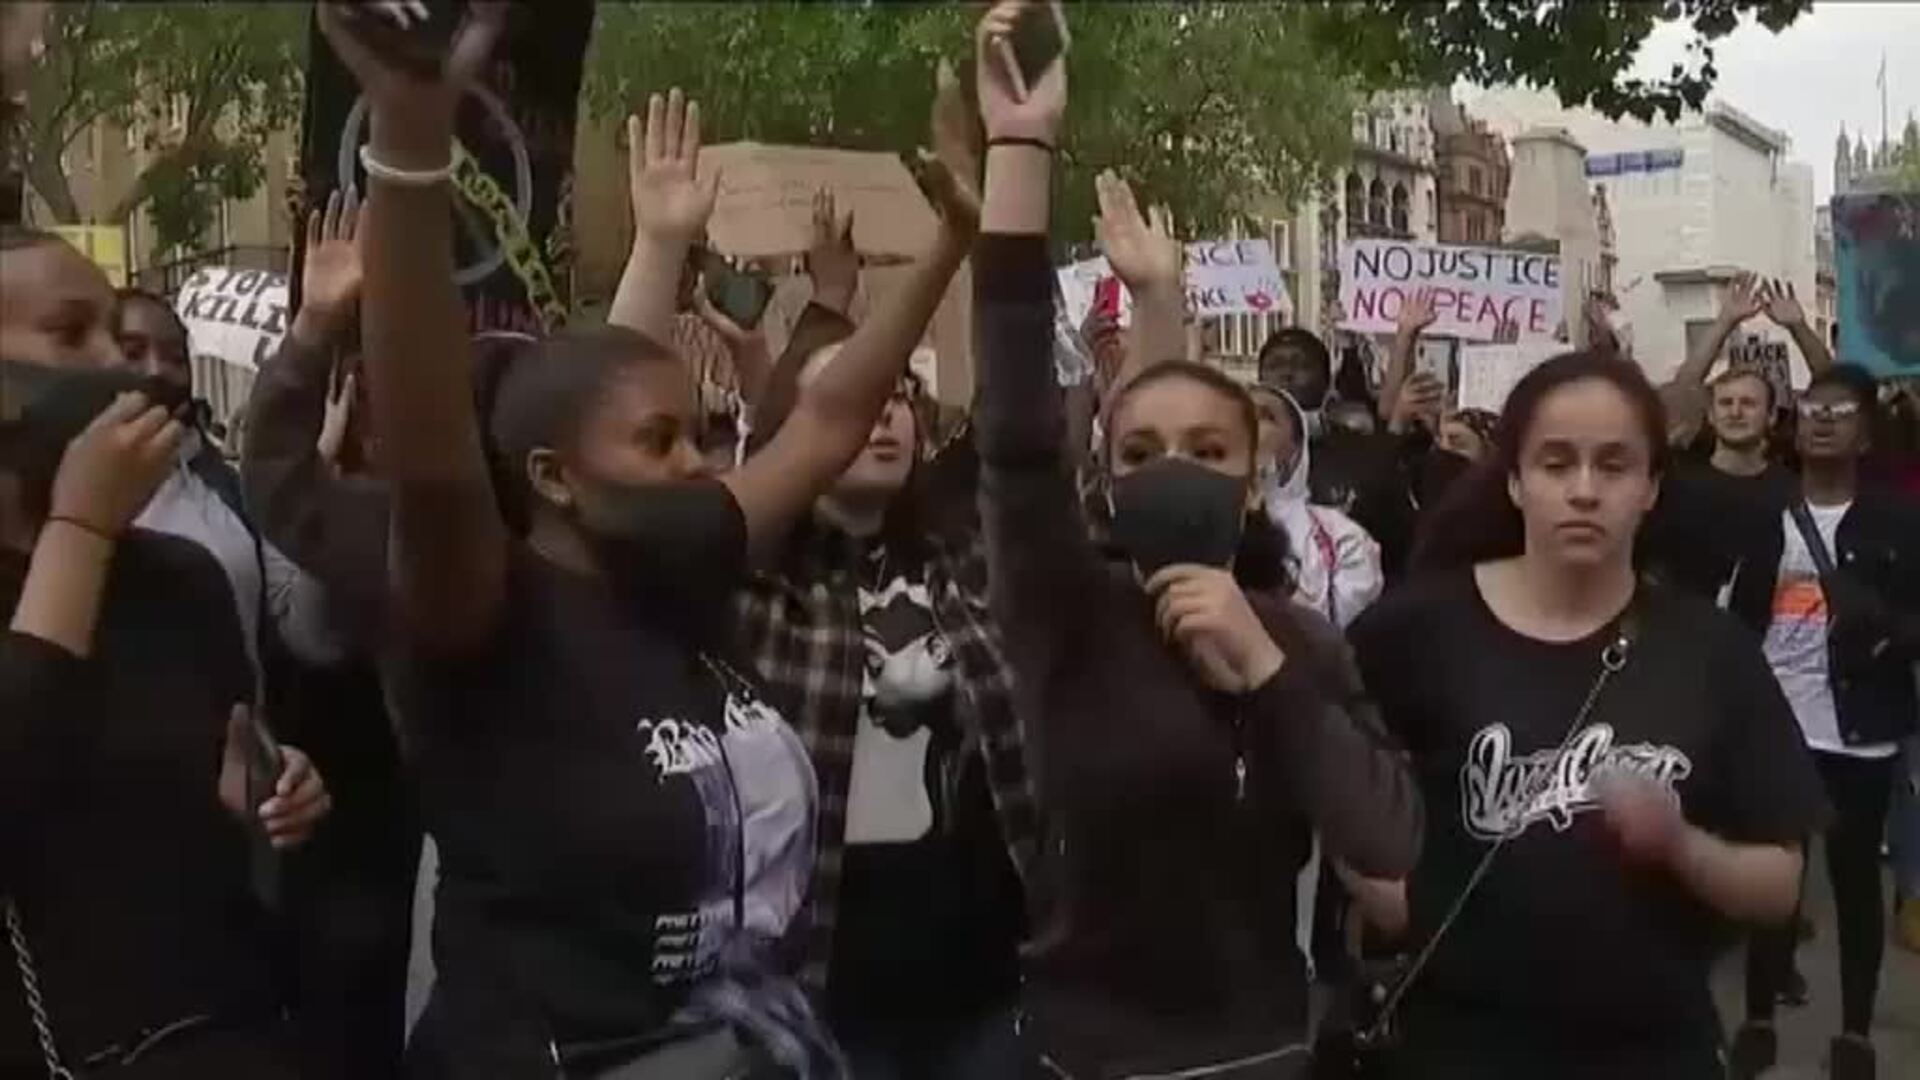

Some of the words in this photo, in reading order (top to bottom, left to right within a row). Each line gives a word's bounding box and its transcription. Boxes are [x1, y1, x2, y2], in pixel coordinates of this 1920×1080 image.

[1353, 246, 1412, 281] NO
[1417, 249, 1560, 289] JUSTICE
[182, 291, 286, 334] KILLI
[1353, 286, 1406, 322] NO
[1429, 286, 1547, 333] PEACE
